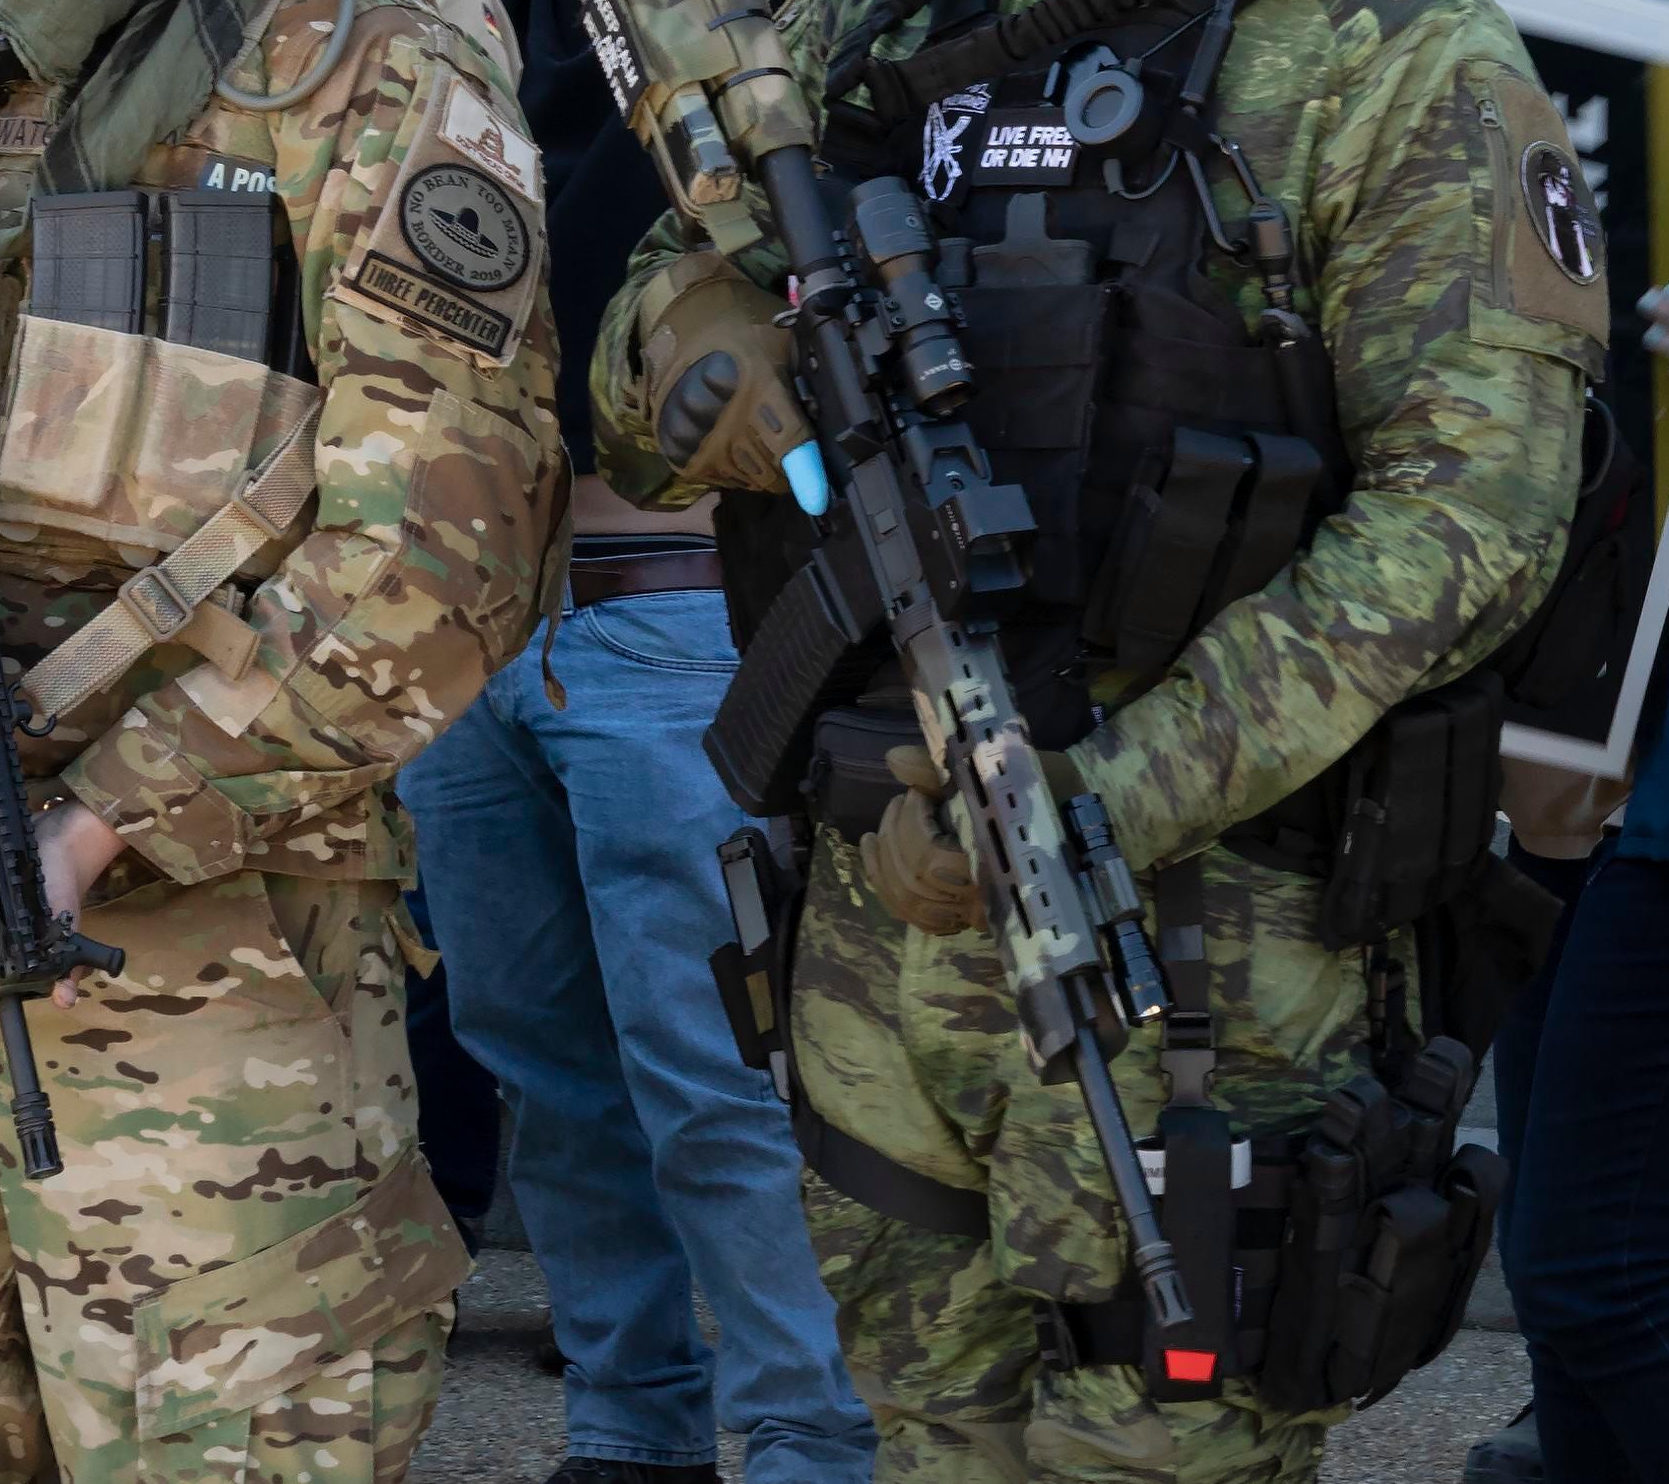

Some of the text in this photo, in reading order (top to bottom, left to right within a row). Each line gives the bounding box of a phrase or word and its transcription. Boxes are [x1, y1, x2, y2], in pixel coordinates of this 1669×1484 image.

[615, 36, 640, 89] CALM
[981, 149, 1072, 168] OR DIE NH
[987, 126, 1075, 146] LIVE FREE
[410, 174, 521, 270] NO BEAN TOO MEAN
[411, 221, 503, 281] BORDER 2019
[366, 263, 501, 343] THREE PERCENTER
